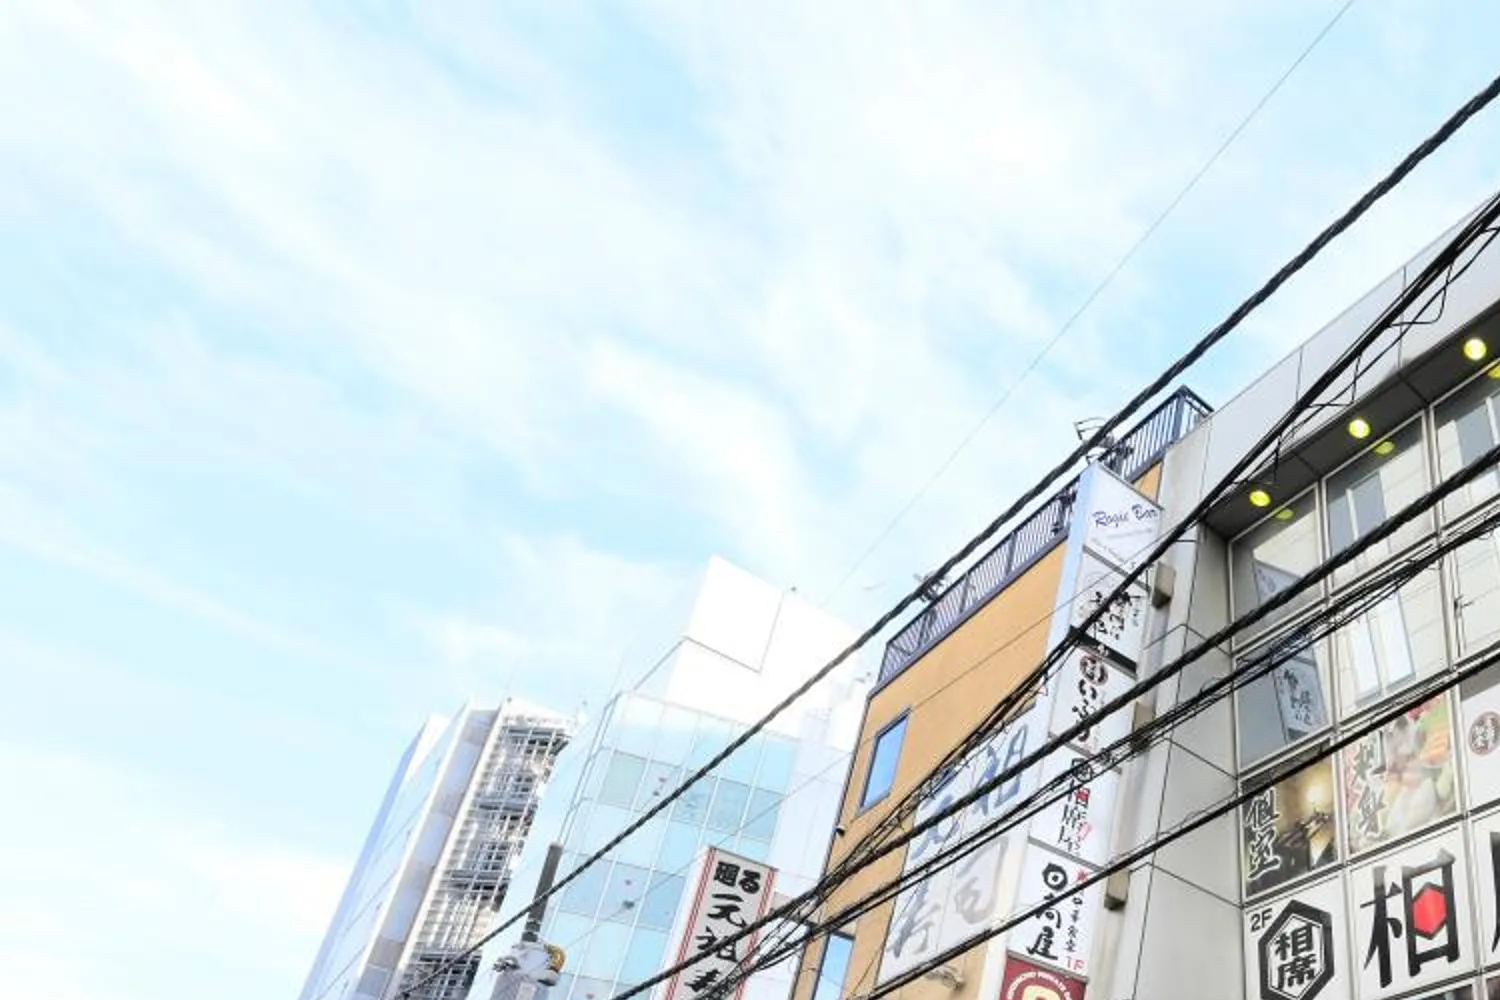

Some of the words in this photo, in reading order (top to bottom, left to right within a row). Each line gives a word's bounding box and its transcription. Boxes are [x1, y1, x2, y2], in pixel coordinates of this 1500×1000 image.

[1246, 787, 1281, 881] 個室
[1250, 908, 1273, 932] 2F
[1274, 925, 1317, 992] 相席
